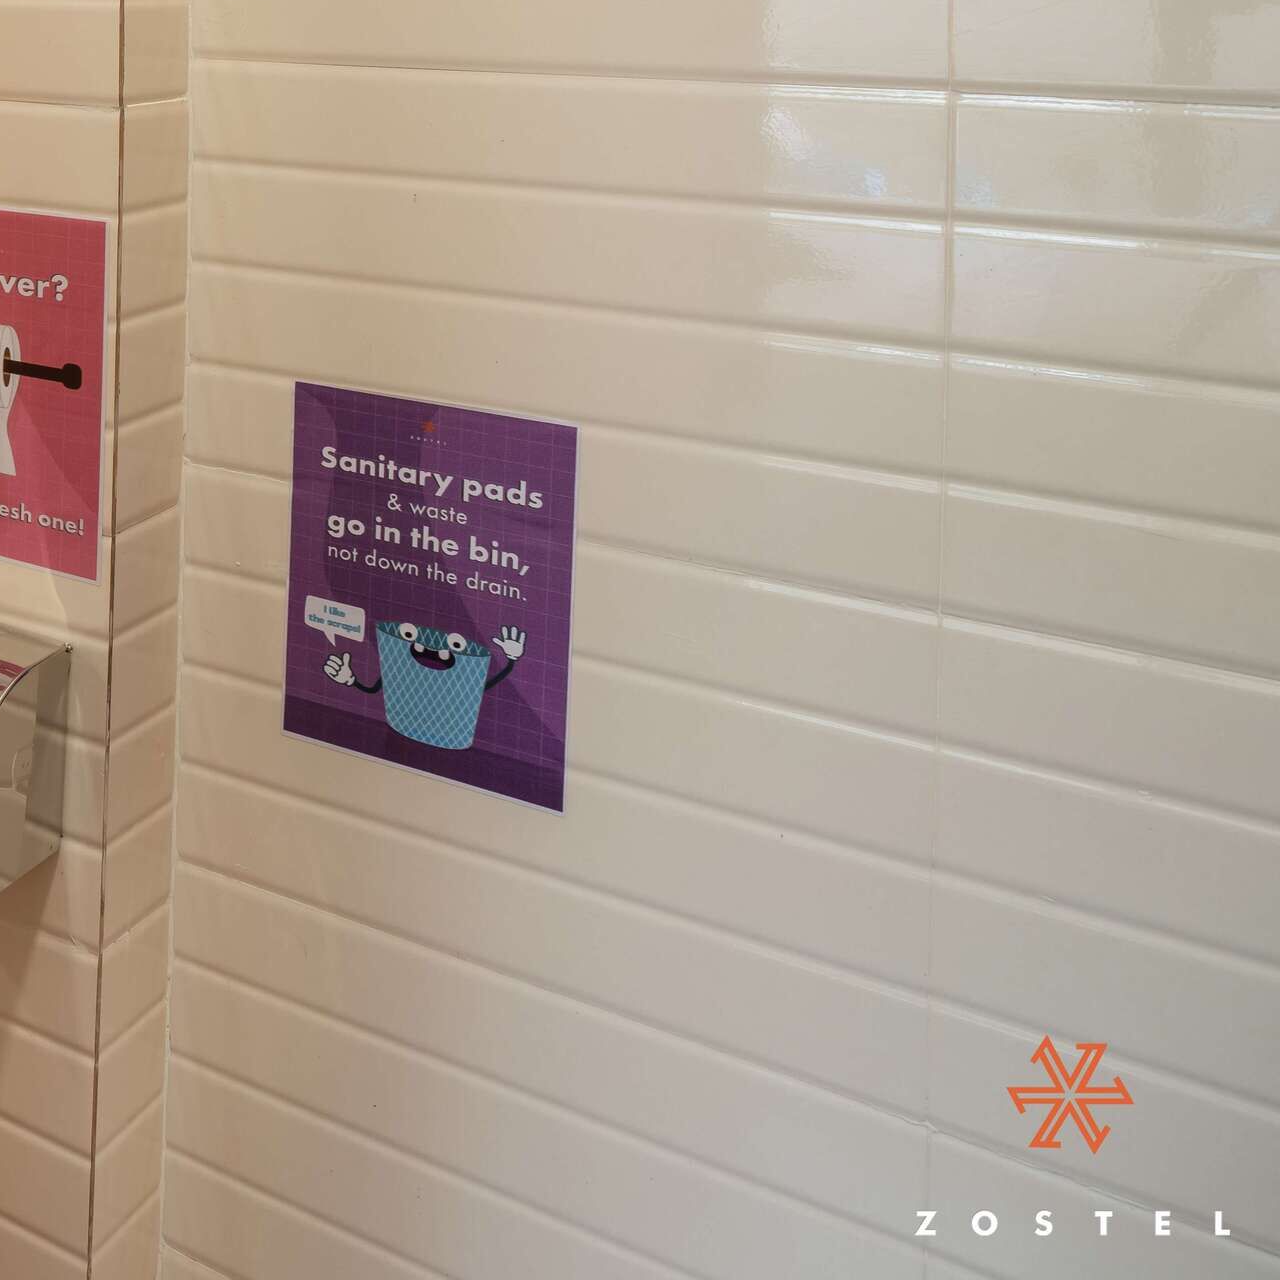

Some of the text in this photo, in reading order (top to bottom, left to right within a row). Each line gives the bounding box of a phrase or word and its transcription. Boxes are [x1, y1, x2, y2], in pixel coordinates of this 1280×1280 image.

[320, 446, 544, 509] Sanitary pads
[38, 514, 85, 536] one!
[387, 493, 468, 525] & waste
[327, 514, 530, 577] go in the bin,
[327, 544, 528, 601] not down the drain.
[308, 613, 325, 624] the
[329, 606, 346, 618] like
